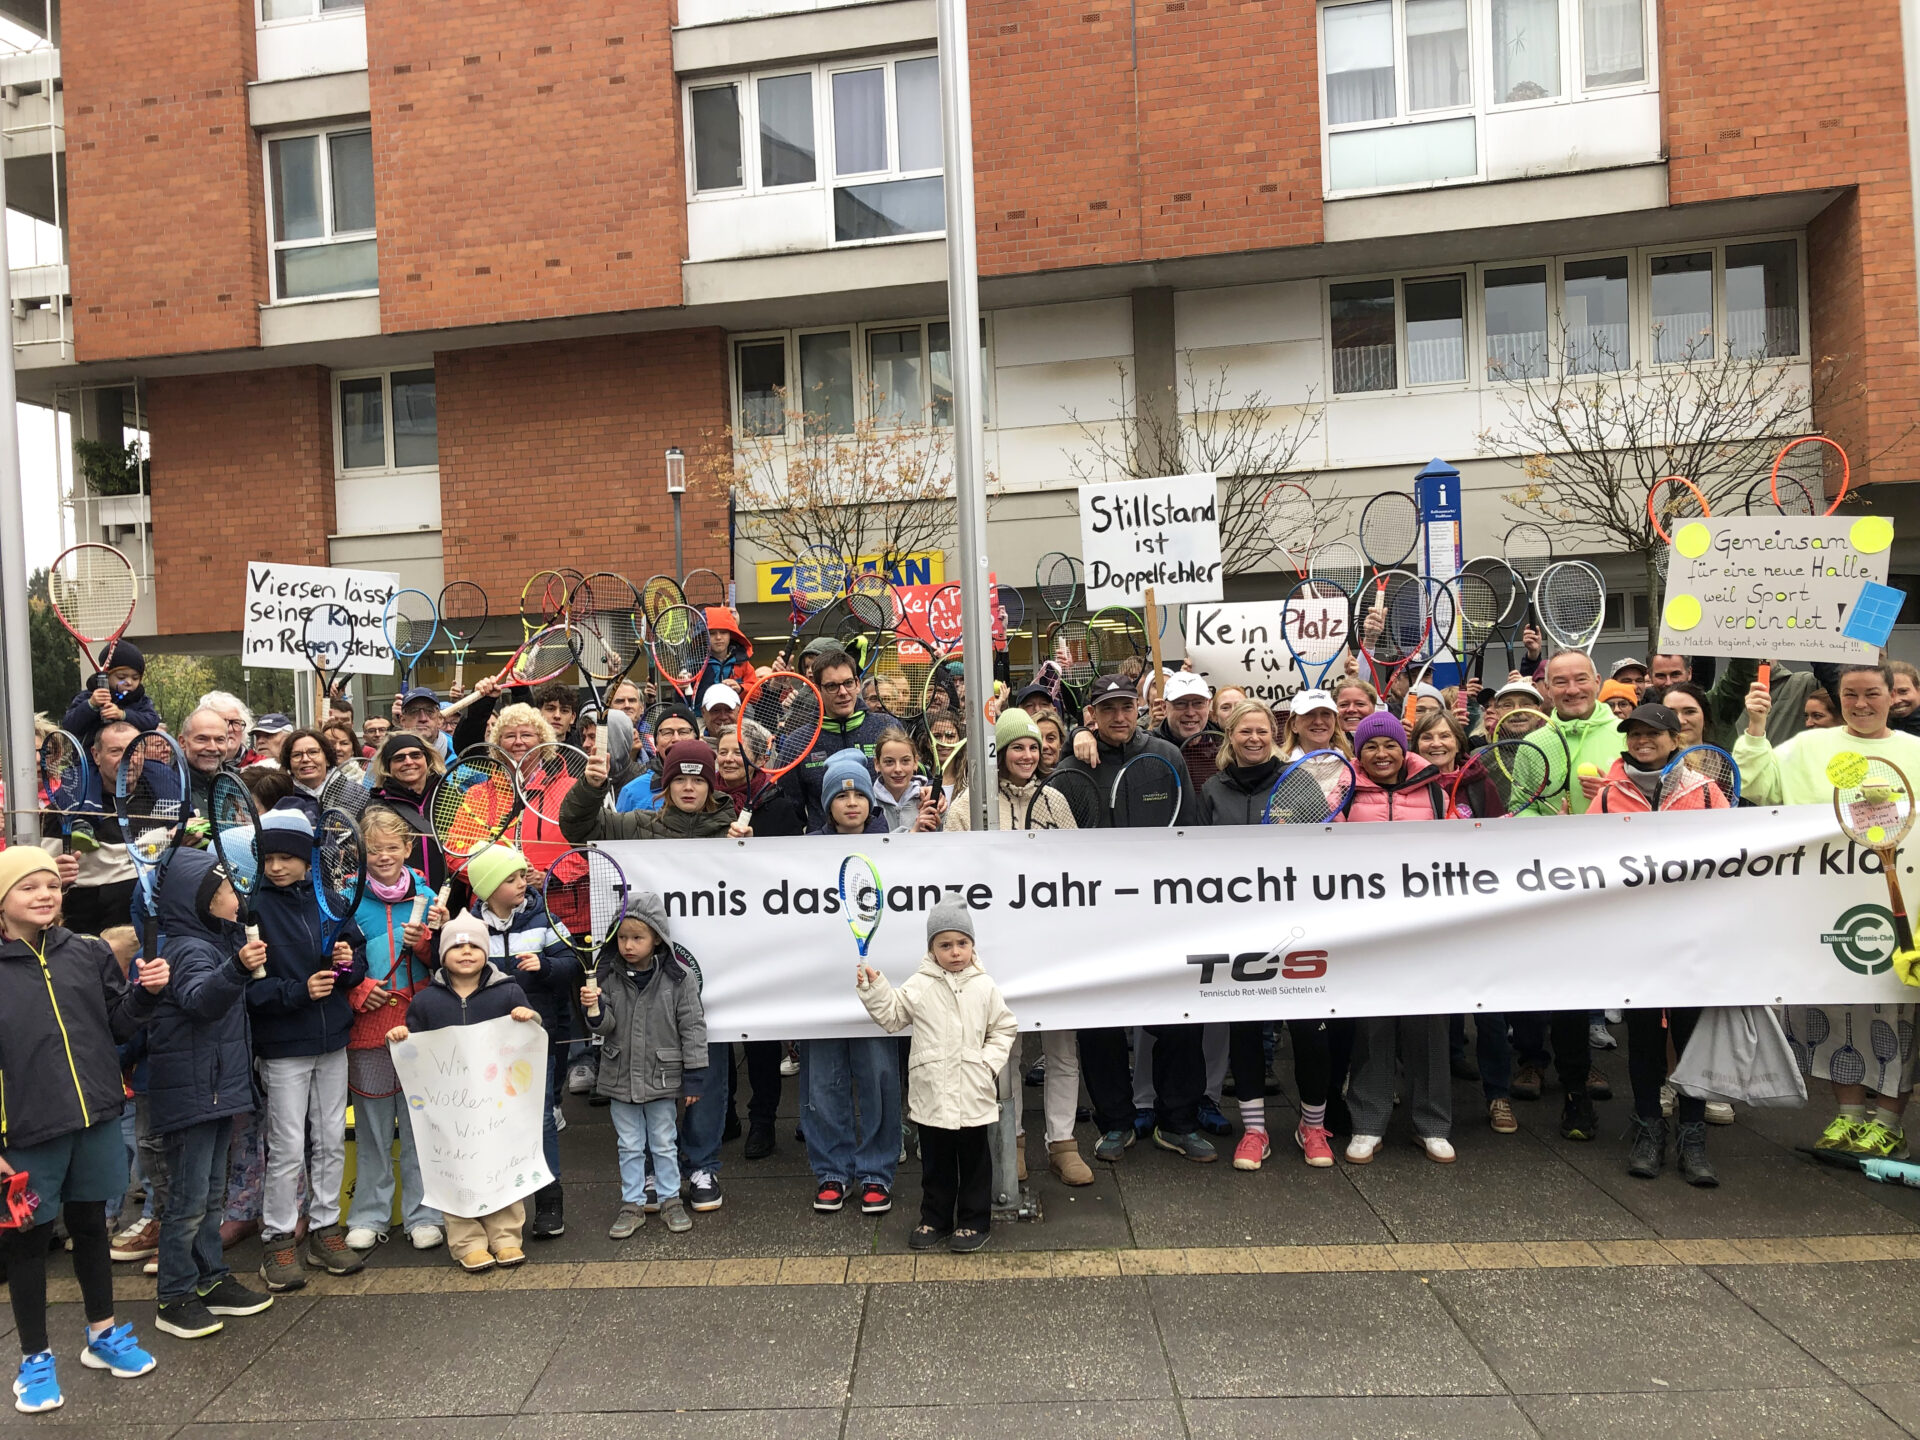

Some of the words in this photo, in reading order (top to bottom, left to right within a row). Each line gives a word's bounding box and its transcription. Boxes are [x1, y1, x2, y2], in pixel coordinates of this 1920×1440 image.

[1091, 493, 1216, 533] Stillstand
[1134, 532, 1170, 555] ist
[1714, 529, 1849, 559] Gemeinsam
[1087, 560, 1222, 595] Doppelfehler
[1688, 560, 1718, 584] für
[1723, 562, 1757, 578] eine
[1764, 566, 1806, 577] neue
[1812, 555, 1879, 581] Halle,
[250, 568, 336, 599] Viersen
[344, 577, 395, 605] lässt
[1704, 585, 1737, 603] weil
[1747, 583, 1811, 609] Sport
[250, 601, 314, 623] seine
[328, 605, 397, 628] Kinder
[896, 591, 946, 614] Kein
[1196, 609, 1268, 646] Kein
[1280, 608, 1348, 640] Platz
[246, 630, 273, 655] im
[277, 628, 339, 658] Regen
[1663, 637, 1681, 647] Das
[1684, 637, 1713, 647] Match
[1772, 638, 1796, 652] geben
[1800, 638, 1825, 649] nicht
[1829, 641, 1849, 652] auf
[1241, 648, 1307, 672] für
[763, 879, 840, 915] das
[1008, 871, 1102, 909] Jahr
[1153, 867, 1297, 905] macht
[1313, 872, 1386, 900] uns
[1402, 862, 1500, 898] bitte
[1516, 859, 1606, 893] den
[1619, 845, 1807, 887] Standort
[1823, 934, 1853, 943] Dülkener
[1856, 934, 1894, 942] Tennis-Club
[1186, 950, 1328, 984] TCS
[1199, 986, 1241, 998] Tennisclub
[1242, 986, 1278, 996] Rot-Weiß
[1279, 985, 1313, 995] Süchteln
[1314, 985, 1327, 993] e.V.
